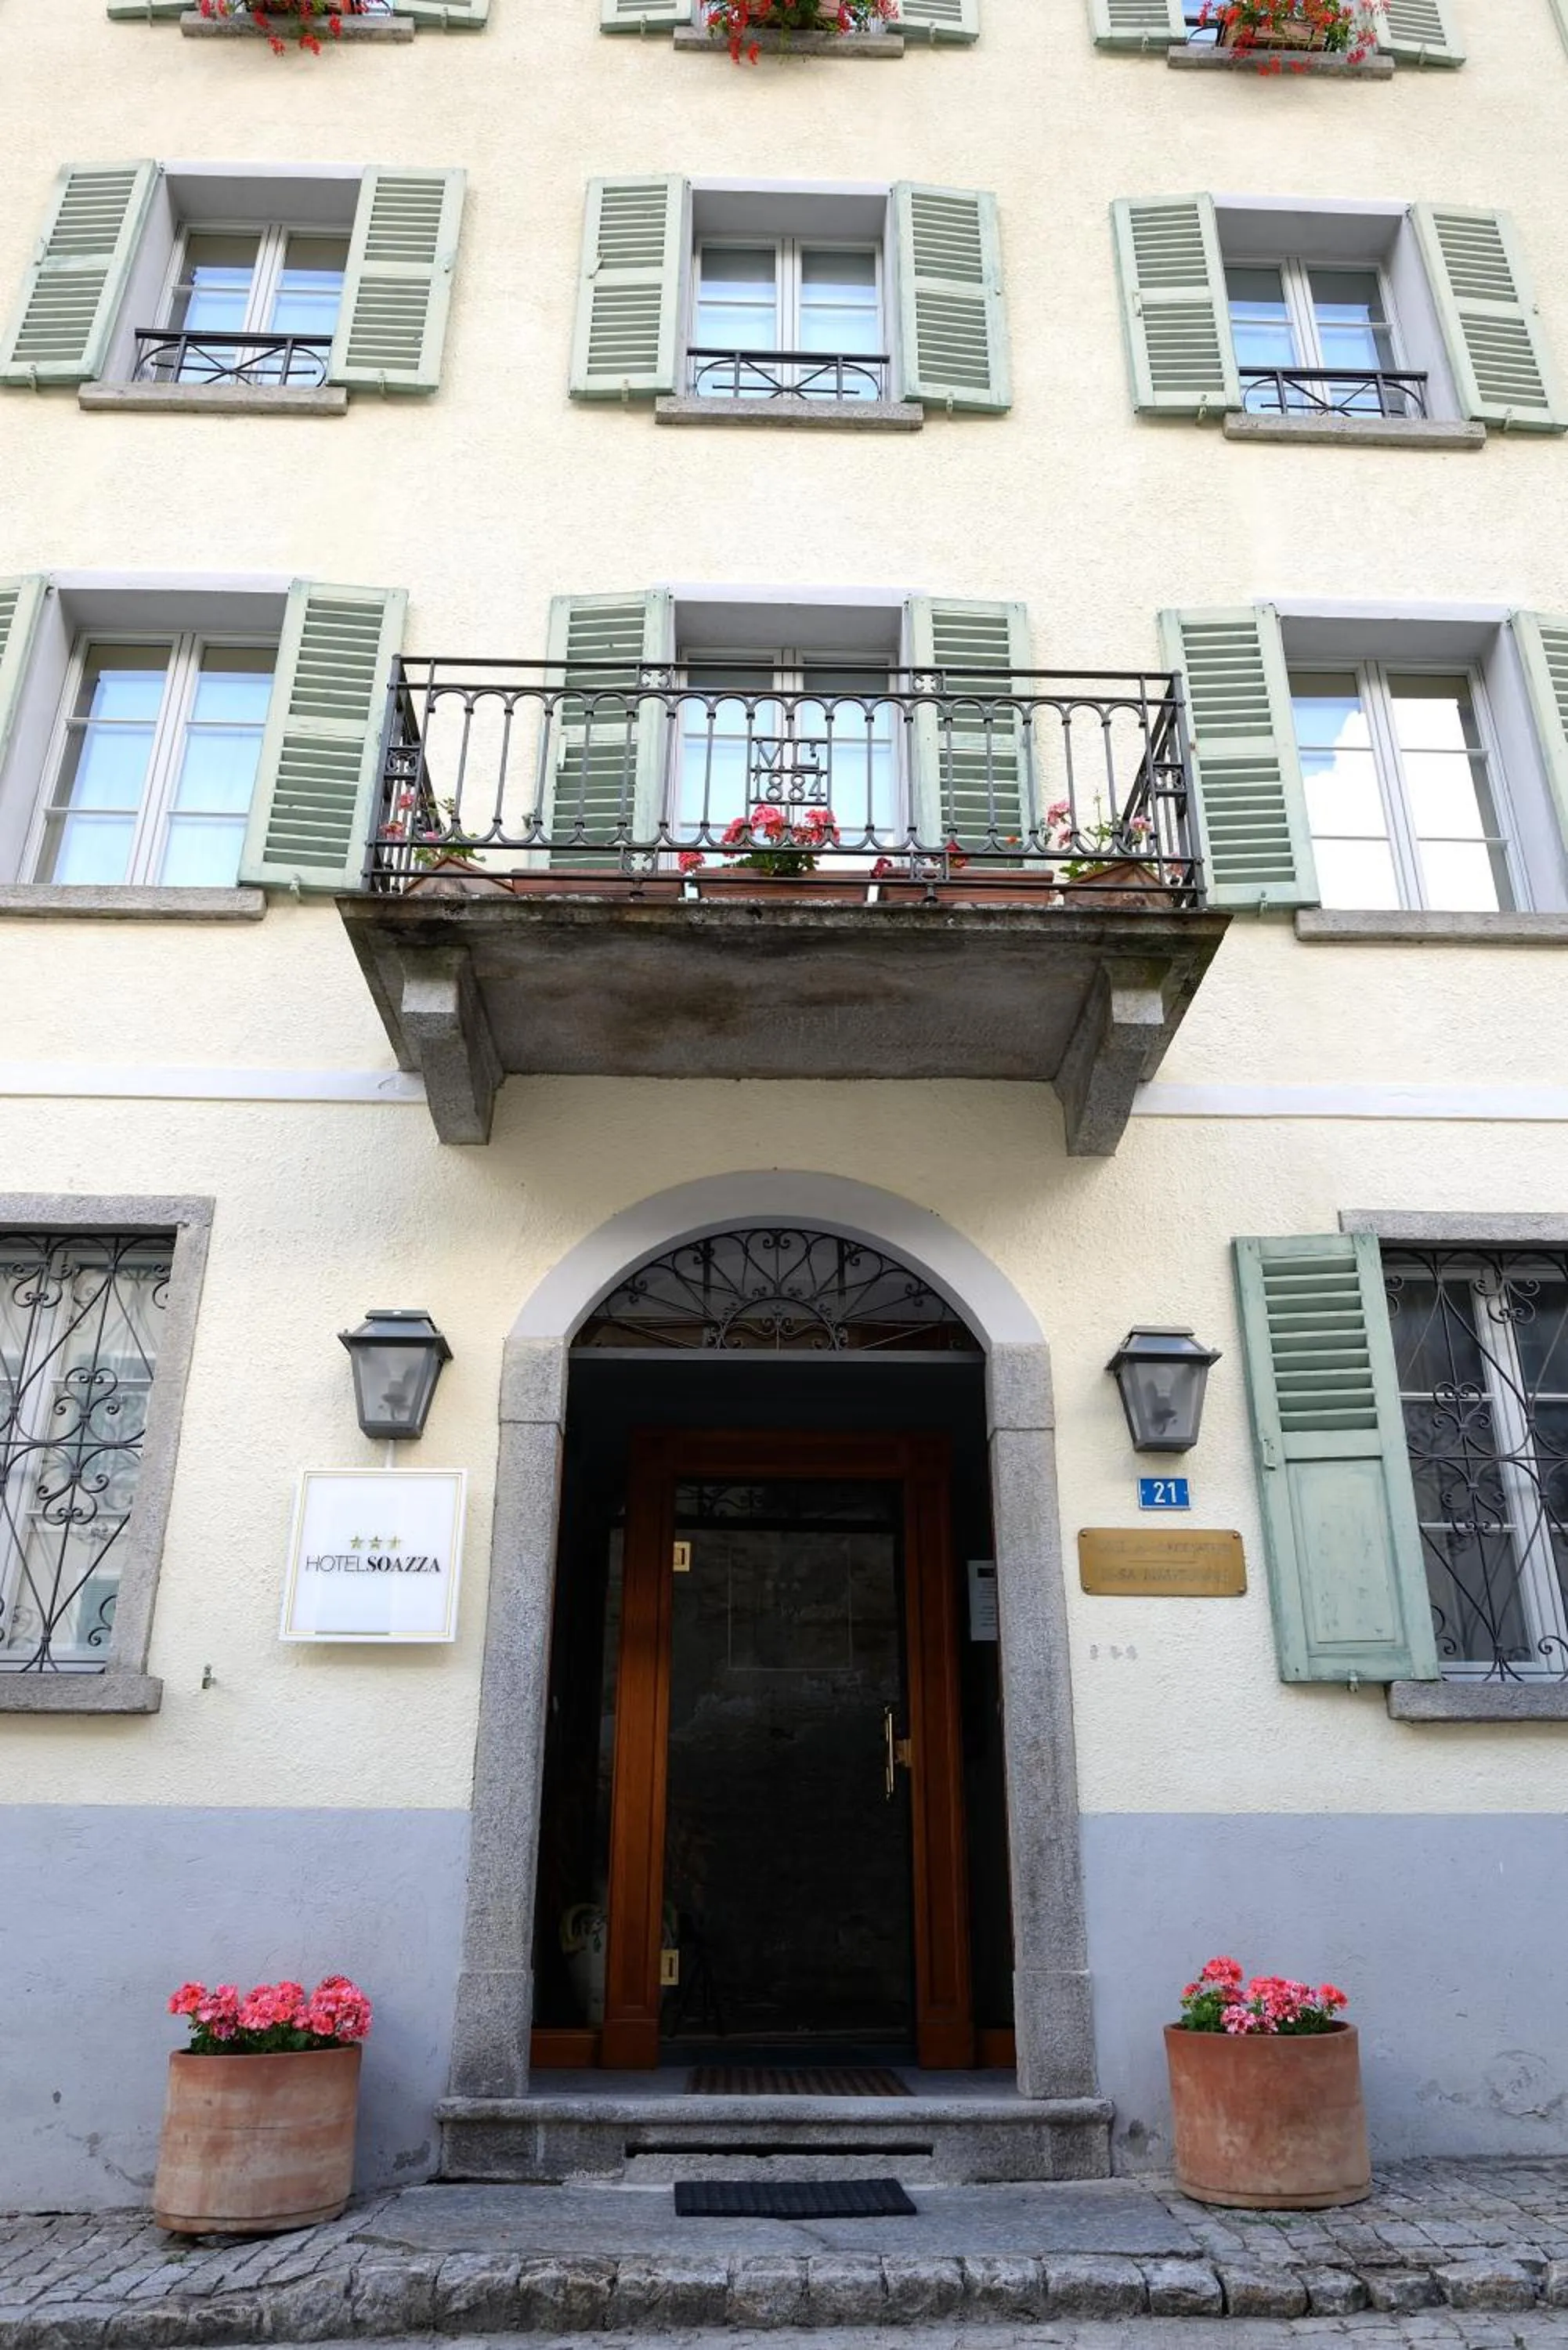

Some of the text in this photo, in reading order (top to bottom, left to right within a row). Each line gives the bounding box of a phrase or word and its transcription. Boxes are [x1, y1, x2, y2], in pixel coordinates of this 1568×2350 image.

[1154, 1481, 1177, 1503] 21
[305, 1555, 441, 1572] HOTEL SOAZZA
